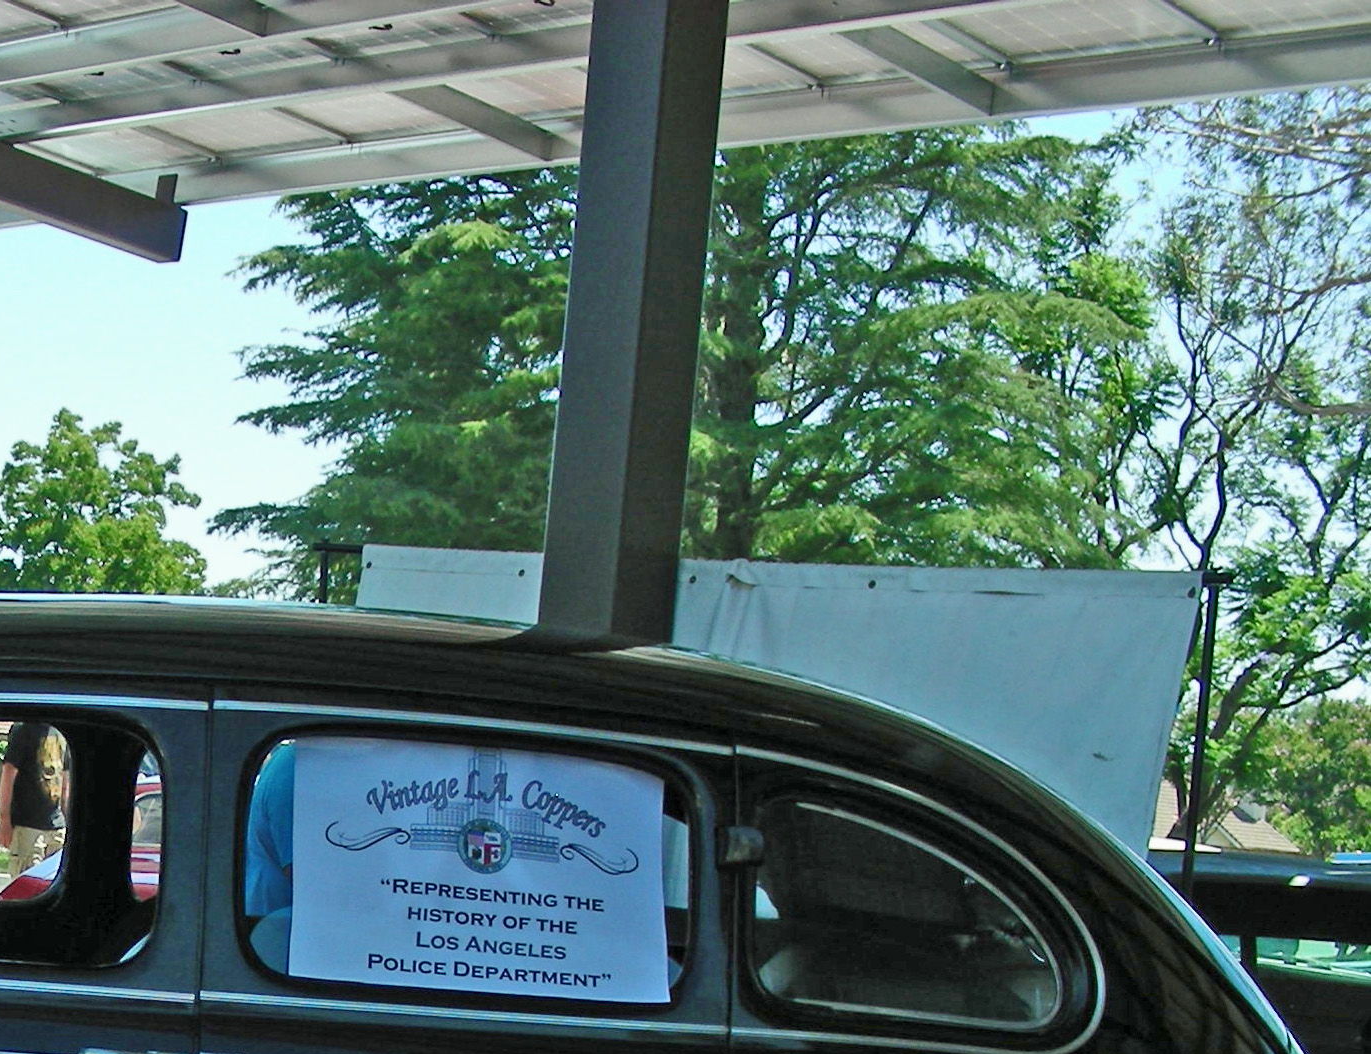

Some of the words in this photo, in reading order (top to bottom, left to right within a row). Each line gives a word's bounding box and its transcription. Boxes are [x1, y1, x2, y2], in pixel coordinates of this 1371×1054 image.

[366, 777, 460, 815] Vintage
[521, 780, 607, 838] Coppers
[563, 895, 605, 912] THE
[407, 906, 498, 928] HISTORY
[502, 915, 531, 930] OF
[535, 919, 578, 935] THE
